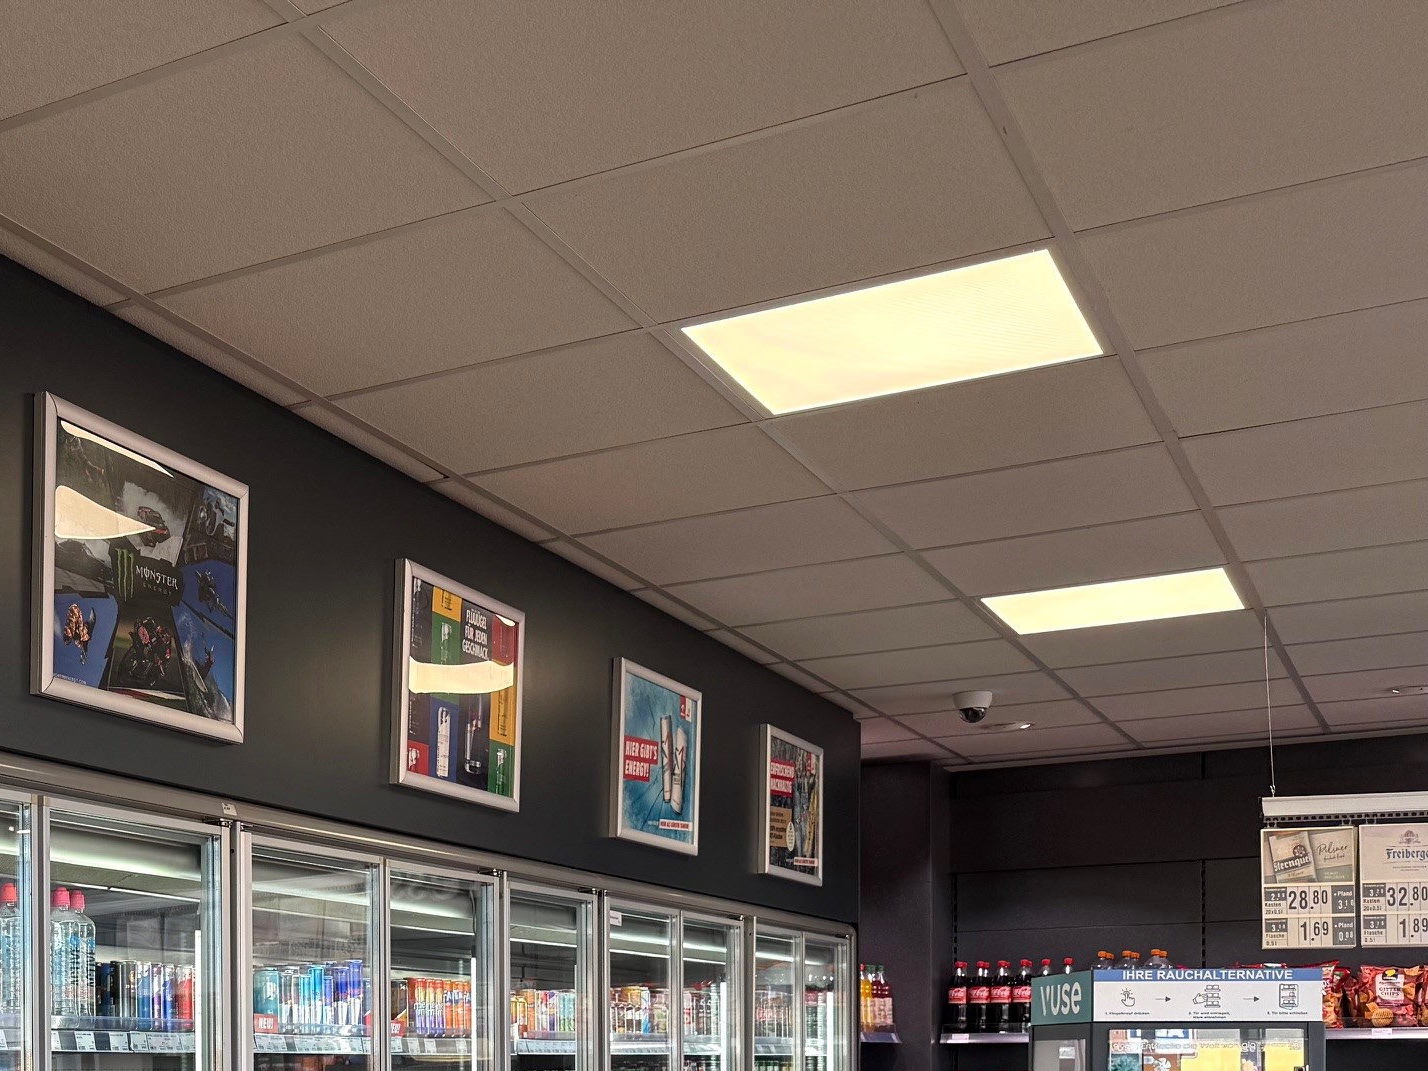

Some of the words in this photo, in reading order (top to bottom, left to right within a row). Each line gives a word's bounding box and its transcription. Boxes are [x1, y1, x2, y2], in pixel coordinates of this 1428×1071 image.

[143, 582, 171, 596] ENERGY
[465, 625, 474, 640] FÜR
[475, 630, 487, 646] JEDEN
[626, 741, 639, 755] HIER
[625, 760, 649, 778] ENERGY!
[1317, 842, 1348, 855] Pilsner
[1289, 890, 1328, 910] 28.80
[1387, 886, 1428, 907] 32.80
[1301, 921, 1329, 941] 1.69
[1122, 970, 1153, 981] IHRE
[1157, 970, 1293, 981] RAUCHALTERNATIVE
[258, 1017, 273, 1030] NEU!
